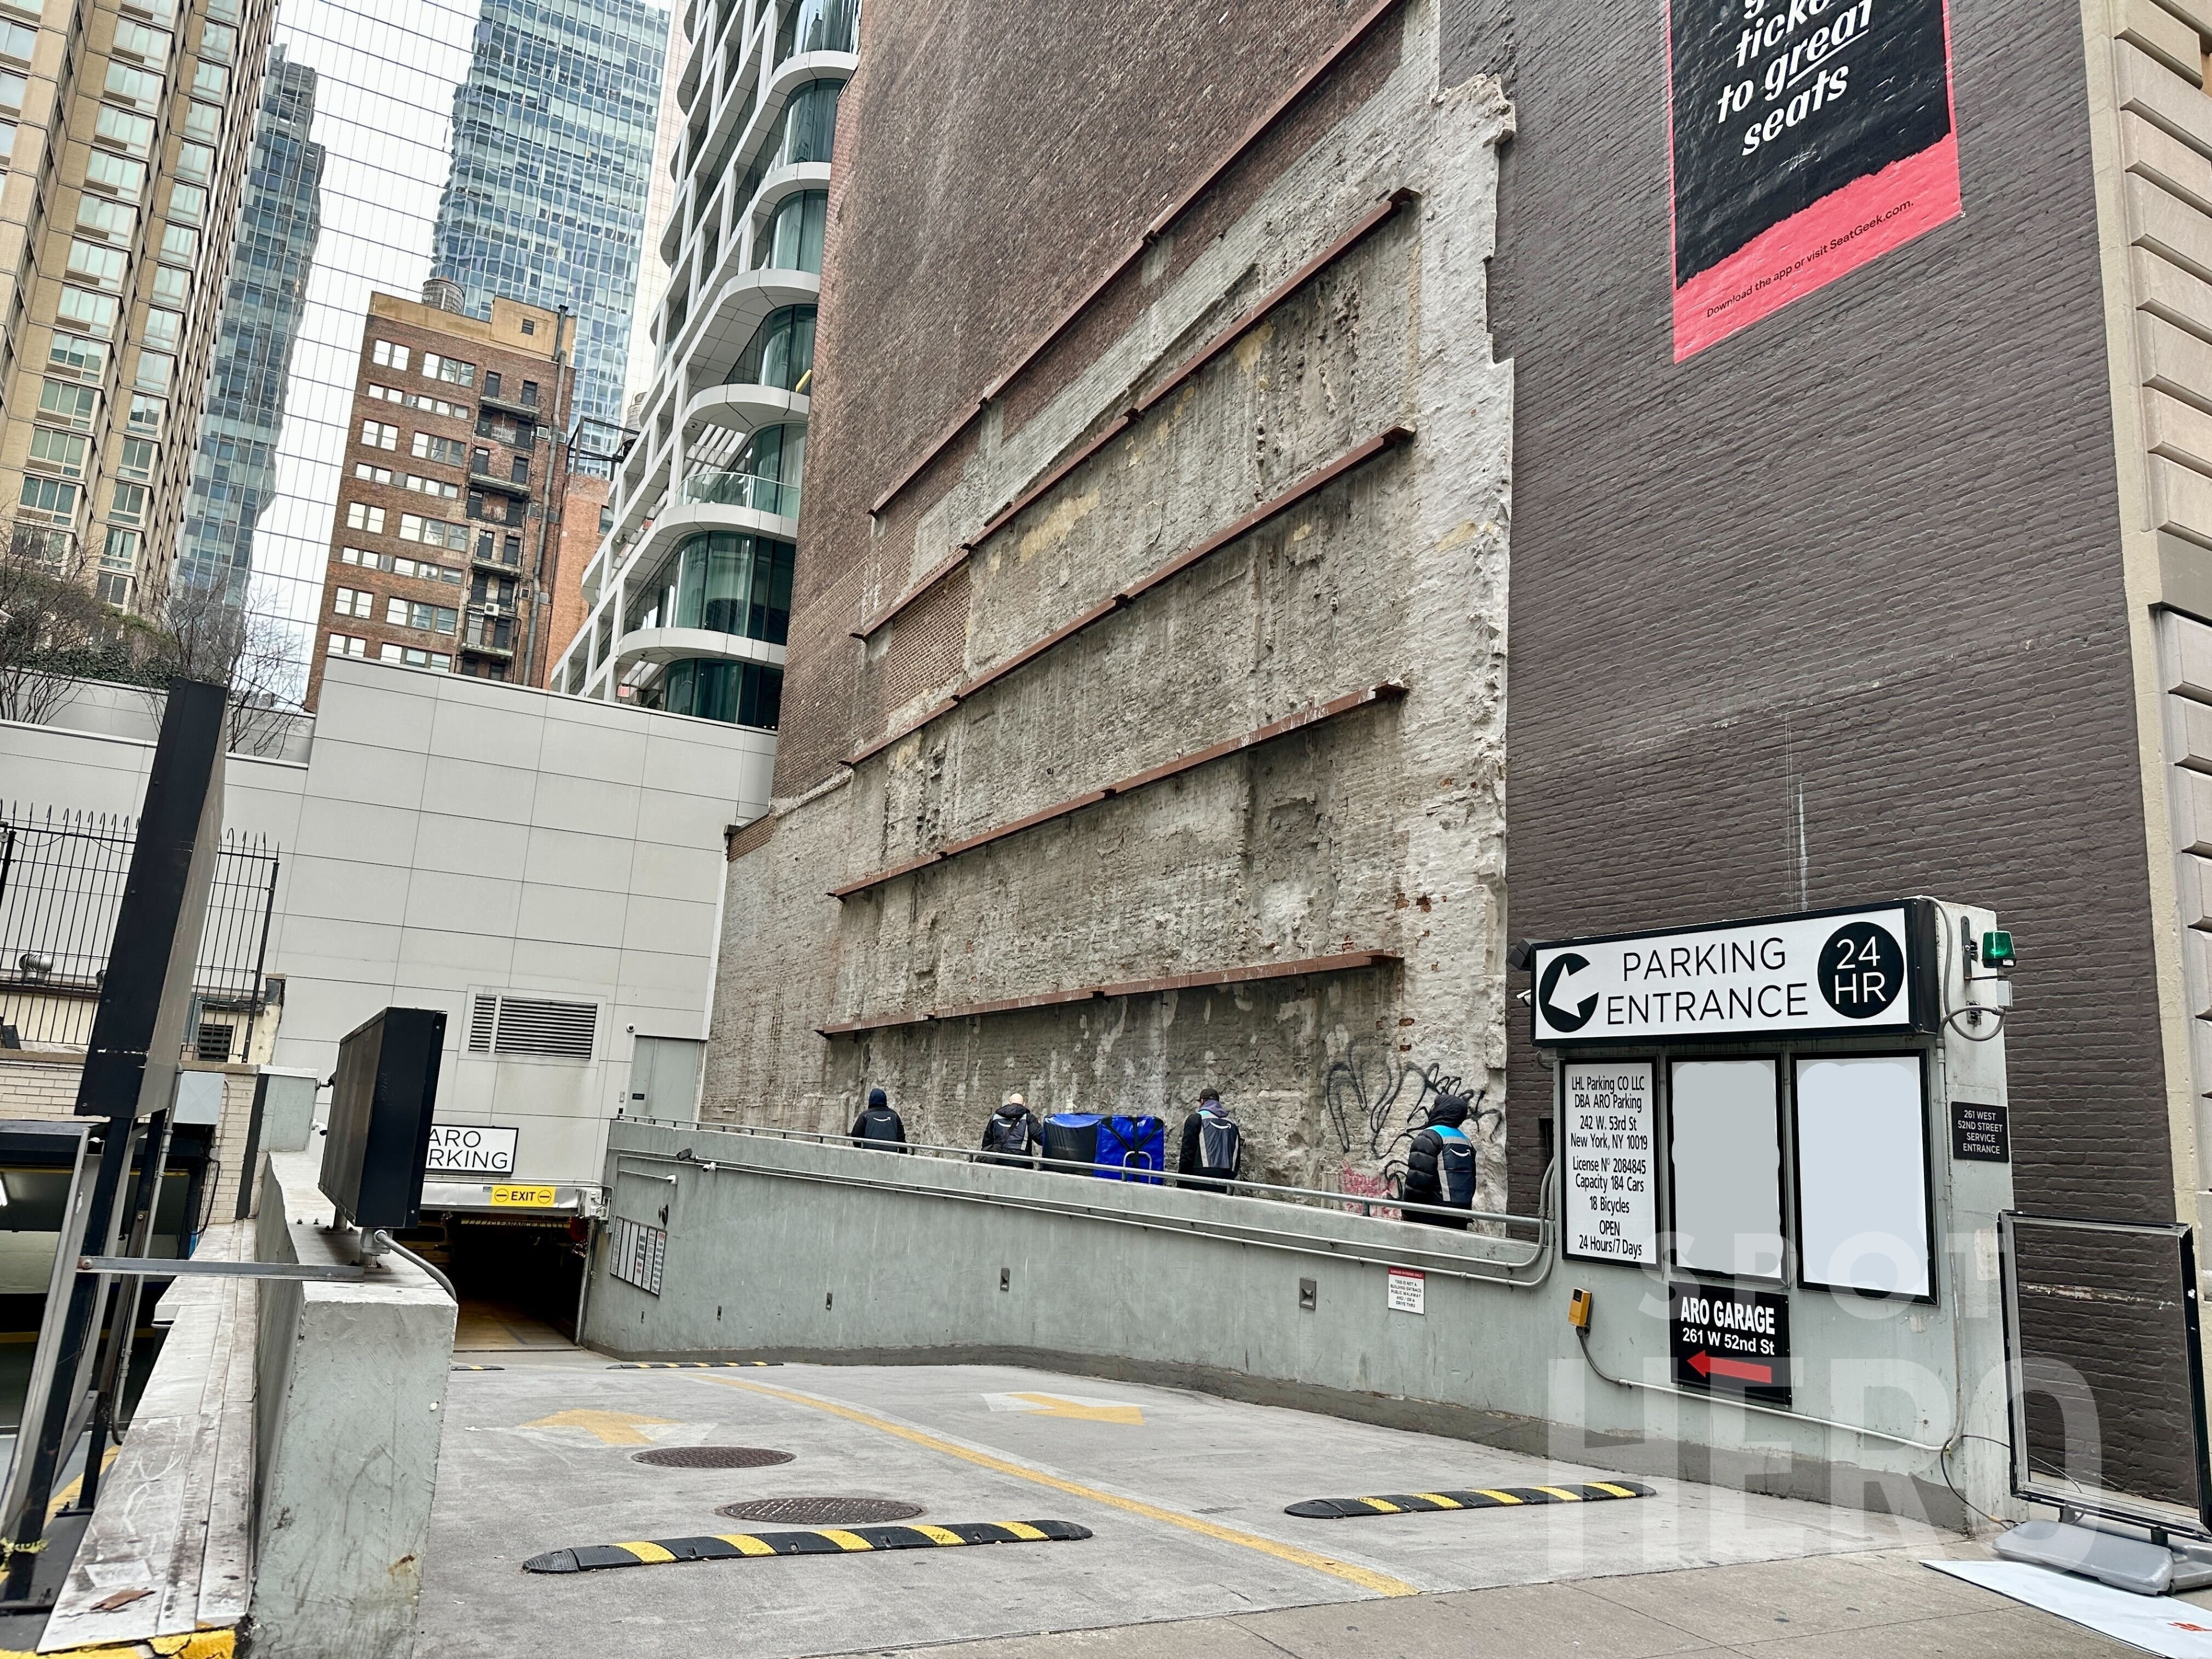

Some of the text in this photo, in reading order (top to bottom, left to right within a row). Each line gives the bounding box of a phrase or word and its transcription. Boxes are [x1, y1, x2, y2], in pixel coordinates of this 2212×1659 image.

[1717, 0, 1873, 124] to great
[1741, 65, 1849, 156] seats
[1706, 199, 1914, 318] Download the app or visit SeatGeek.com.
[1623, 937, 1786, 982] PARKING
[1836, 935, 1881, 970] 24
[1834, 971, 1887, 1005] HR
[1607, 982, 1809, 1025] ENTRANCE
[1571, 1075, 1645, 1095] LHL Parking CO LLC
[1574, 1093, 1642, 1113] DBA ARO Parking
[1580, 1115, 1637, 1131] 242 W. 53rd St
[1964, 1109, 1997, 1121] 261 WEST
[1957, 1120, 2003, 1132] 52ND STREET
[429, 1128, 481, 1148] ARO
[1571, 1132, 1647, 1150] New York, NY 10019
[1966, 1132, 1996, 1143] SERVICE
[1963, 1143, 2001, 1154] ENTRANCE
[428, 1149, 508, 1169] RKING
[1573, 1156, 1599, 1172] License
[1613, 1158, 1646, 1175] 2084845
[1575, 1173, 1644, 1194] Capacity 184 Cars
[510, 1191, 536, 1202] EXIT
[1589, 1195, 1630, 1217] 18 Bicycles
[1599, 1219, 1620, 1237] OPEN
[1579, 1234, 1642, 1260] 24 Hours/7 Days
[1680, 1296, 1775, 1335] ARO GARAGE
[1682, 1327, 1775, 1355] 261 W 52nd St
